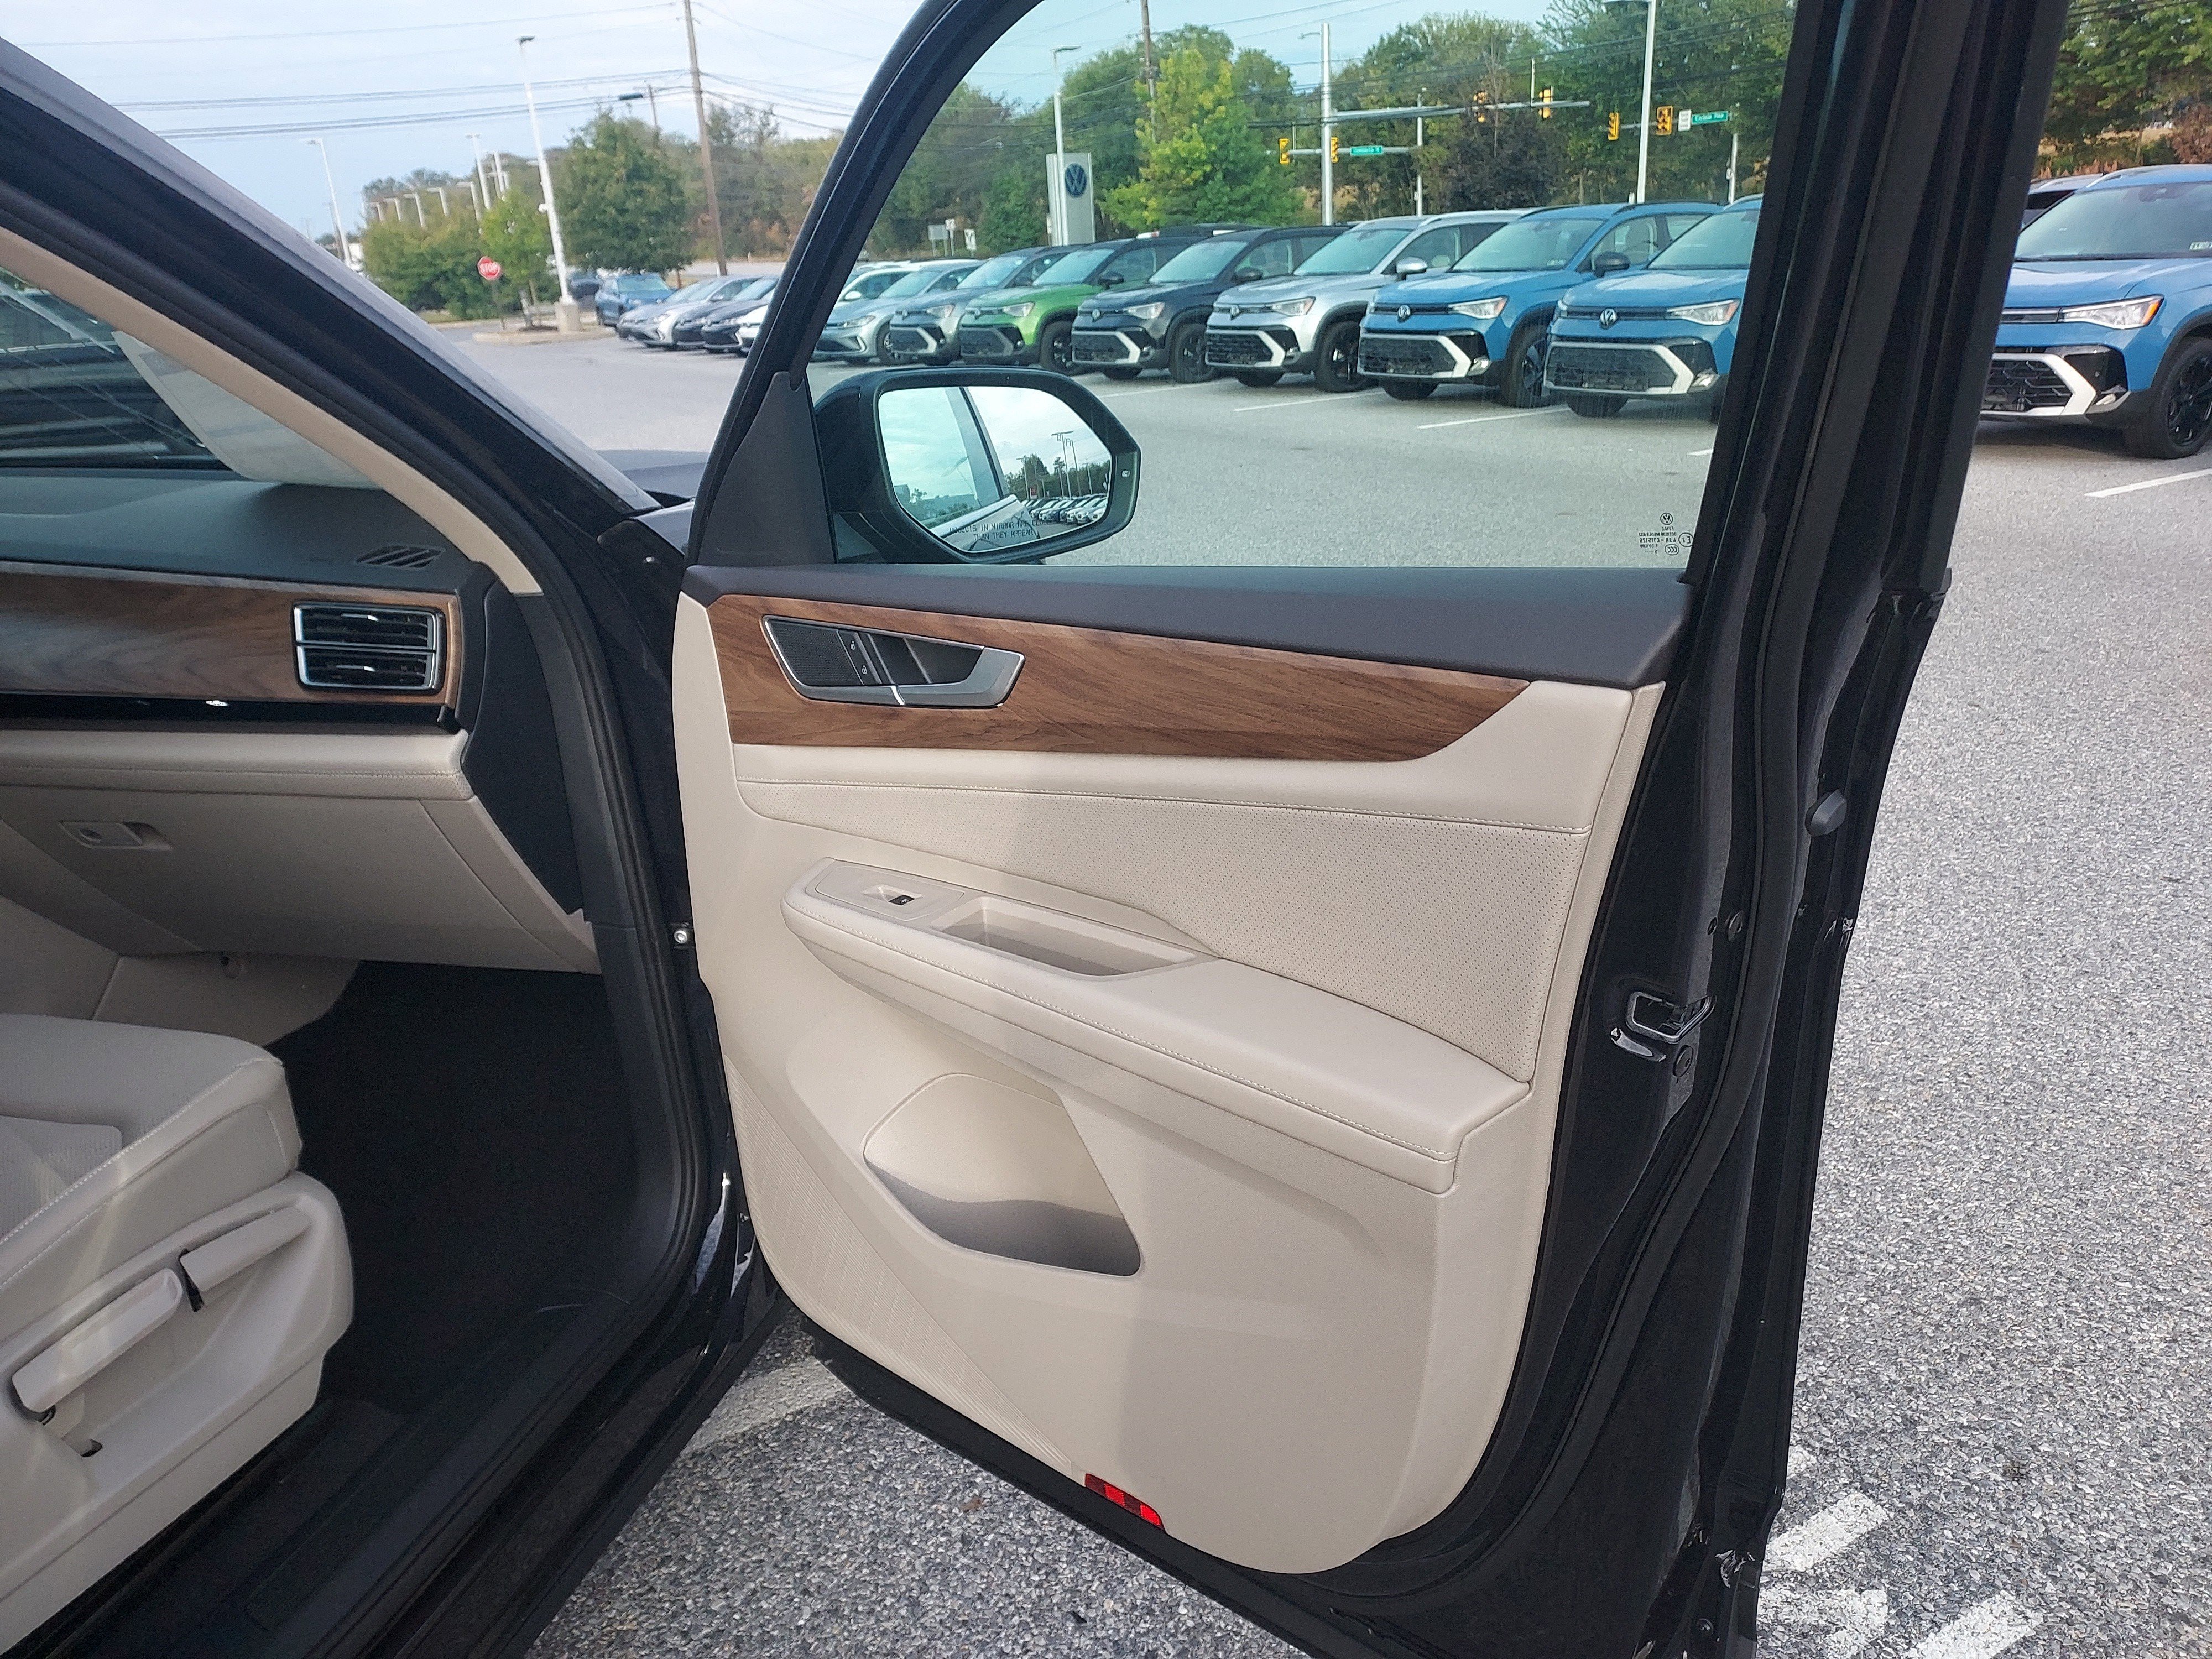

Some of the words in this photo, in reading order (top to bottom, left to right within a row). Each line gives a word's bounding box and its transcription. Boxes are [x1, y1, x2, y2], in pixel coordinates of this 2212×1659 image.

[480, 263, 499, 272] STOP
[973, 533, 989, 541] THAN
[992, 531, 1006, 539] THEY
